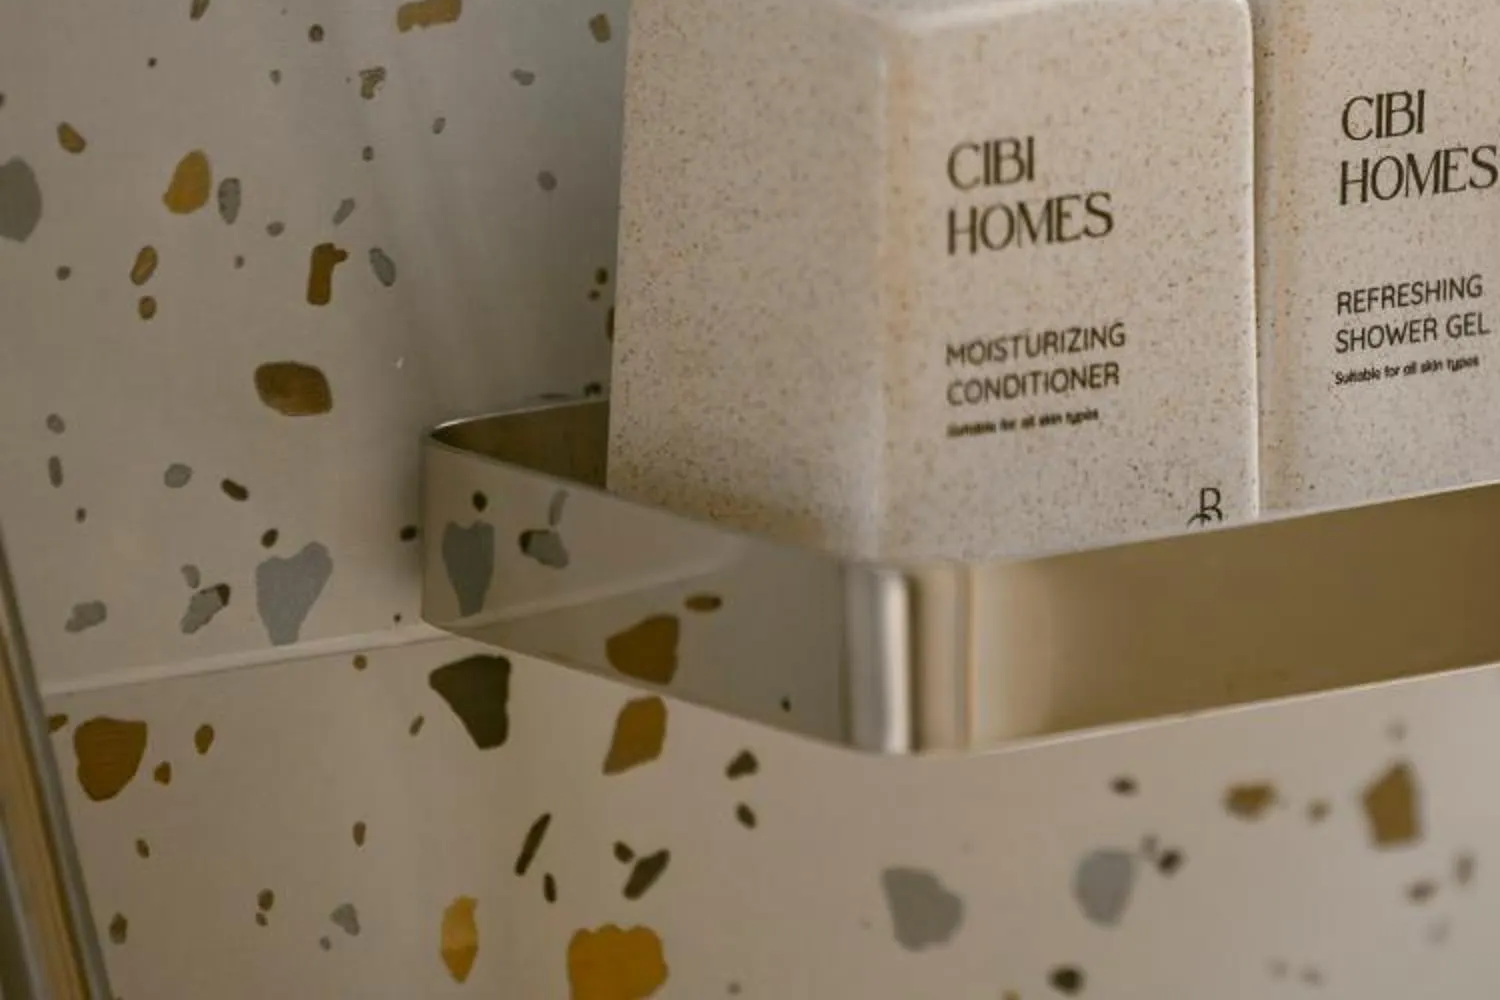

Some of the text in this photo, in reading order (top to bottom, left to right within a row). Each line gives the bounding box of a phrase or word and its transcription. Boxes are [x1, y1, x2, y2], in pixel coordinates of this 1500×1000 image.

[1341, 89, 1426, 140] CIBI
[947, 136, 1034, 190] CIBI
[1340, 144, 1499, 204] HOMES
[947, 192, 1114, 256] HOMES
[1336, 274, 1484, 316] REFRESHING
[946, 322, 1126, 367] MOISTURIZING
[1335, 312, 1491, 353] SHOWER GEL
[947, 362, 1120, 407] CONDITIONER
[1335, 356, 1479, 385] Suitable for all skin types
